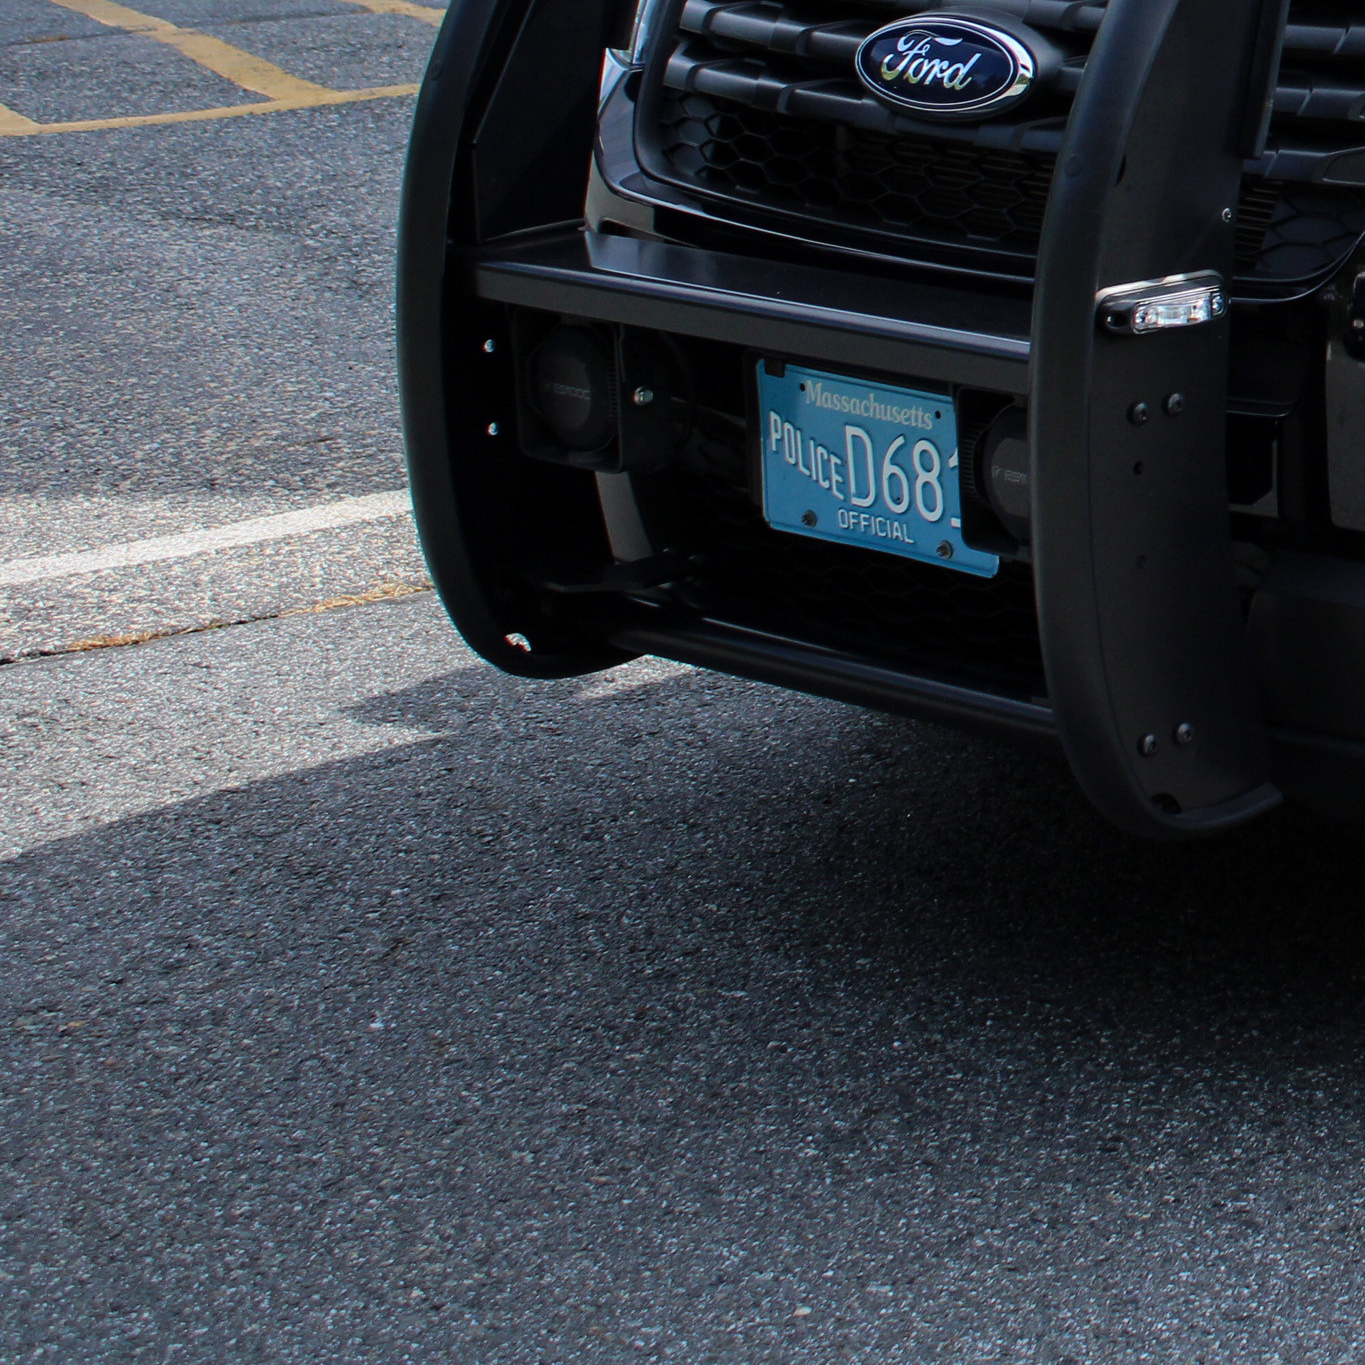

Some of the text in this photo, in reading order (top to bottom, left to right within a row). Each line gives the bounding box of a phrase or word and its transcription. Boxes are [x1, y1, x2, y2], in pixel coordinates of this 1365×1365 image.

[880, 30, 981, 92] Ford
[805, 379, 933, 430] Massachusetts
[769, 411, 845, 500] POLICE
[838, 508, 915, 544] OFFICIAL
